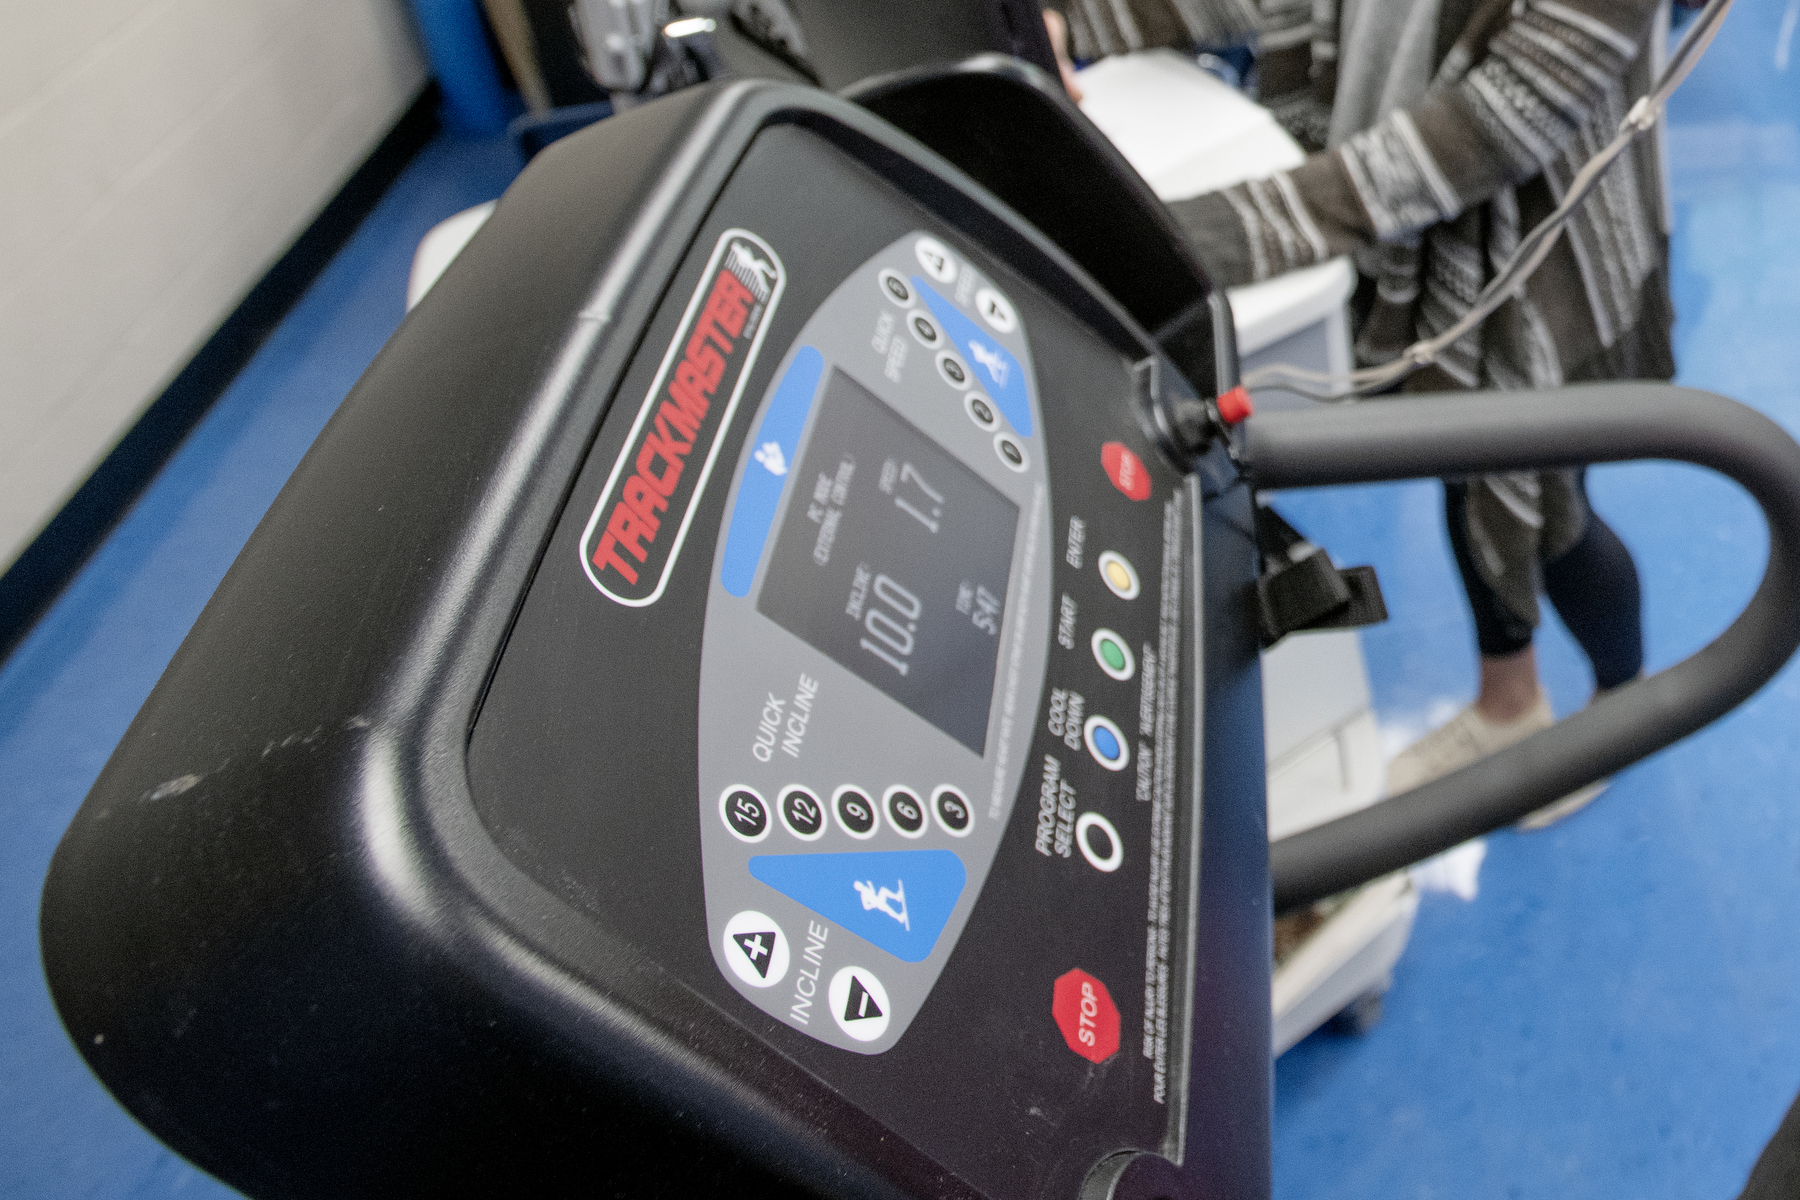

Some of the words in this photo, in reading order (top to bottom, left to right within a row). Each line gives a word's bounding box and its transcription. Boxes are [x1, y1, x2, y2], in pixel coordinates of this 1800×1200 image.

[871, 310, 895, 354] QUICK
[883, 334, 908, 383] SPEED
[592, 268, 755, 585] TRACKMASTER
[895, 462, 944, 534] 1.7
[1119, 450, 1137, 491] STOP
[1066, 515, 1087, 570] ENTER
[860, 573, 922, 677] 10.0
[1058, 591, 1079, 650] START
[752, 691, 787, 762] QUICK
[781, 672, 819, 758] INCLINE
[1048, 686, 1069, 737] COOL
[1063, 690, 1085, 751] DOWN
[733, 797, 760, 826] 15
[791, 797, 817, 825] 12
[846, 801, 869, 821] 9
[896, 800, 918, 821] 6
[943, 800, 965, 820] 3
[1035, 753, 1061, 857] PROGRAM
[1054, 777, 1077, 858] SELECT
[789, 919, 829, 1026] INCLINE
[1078, 981, 1097, 1046] STOP
[1154, 1071, 1166, 1104] POUR
